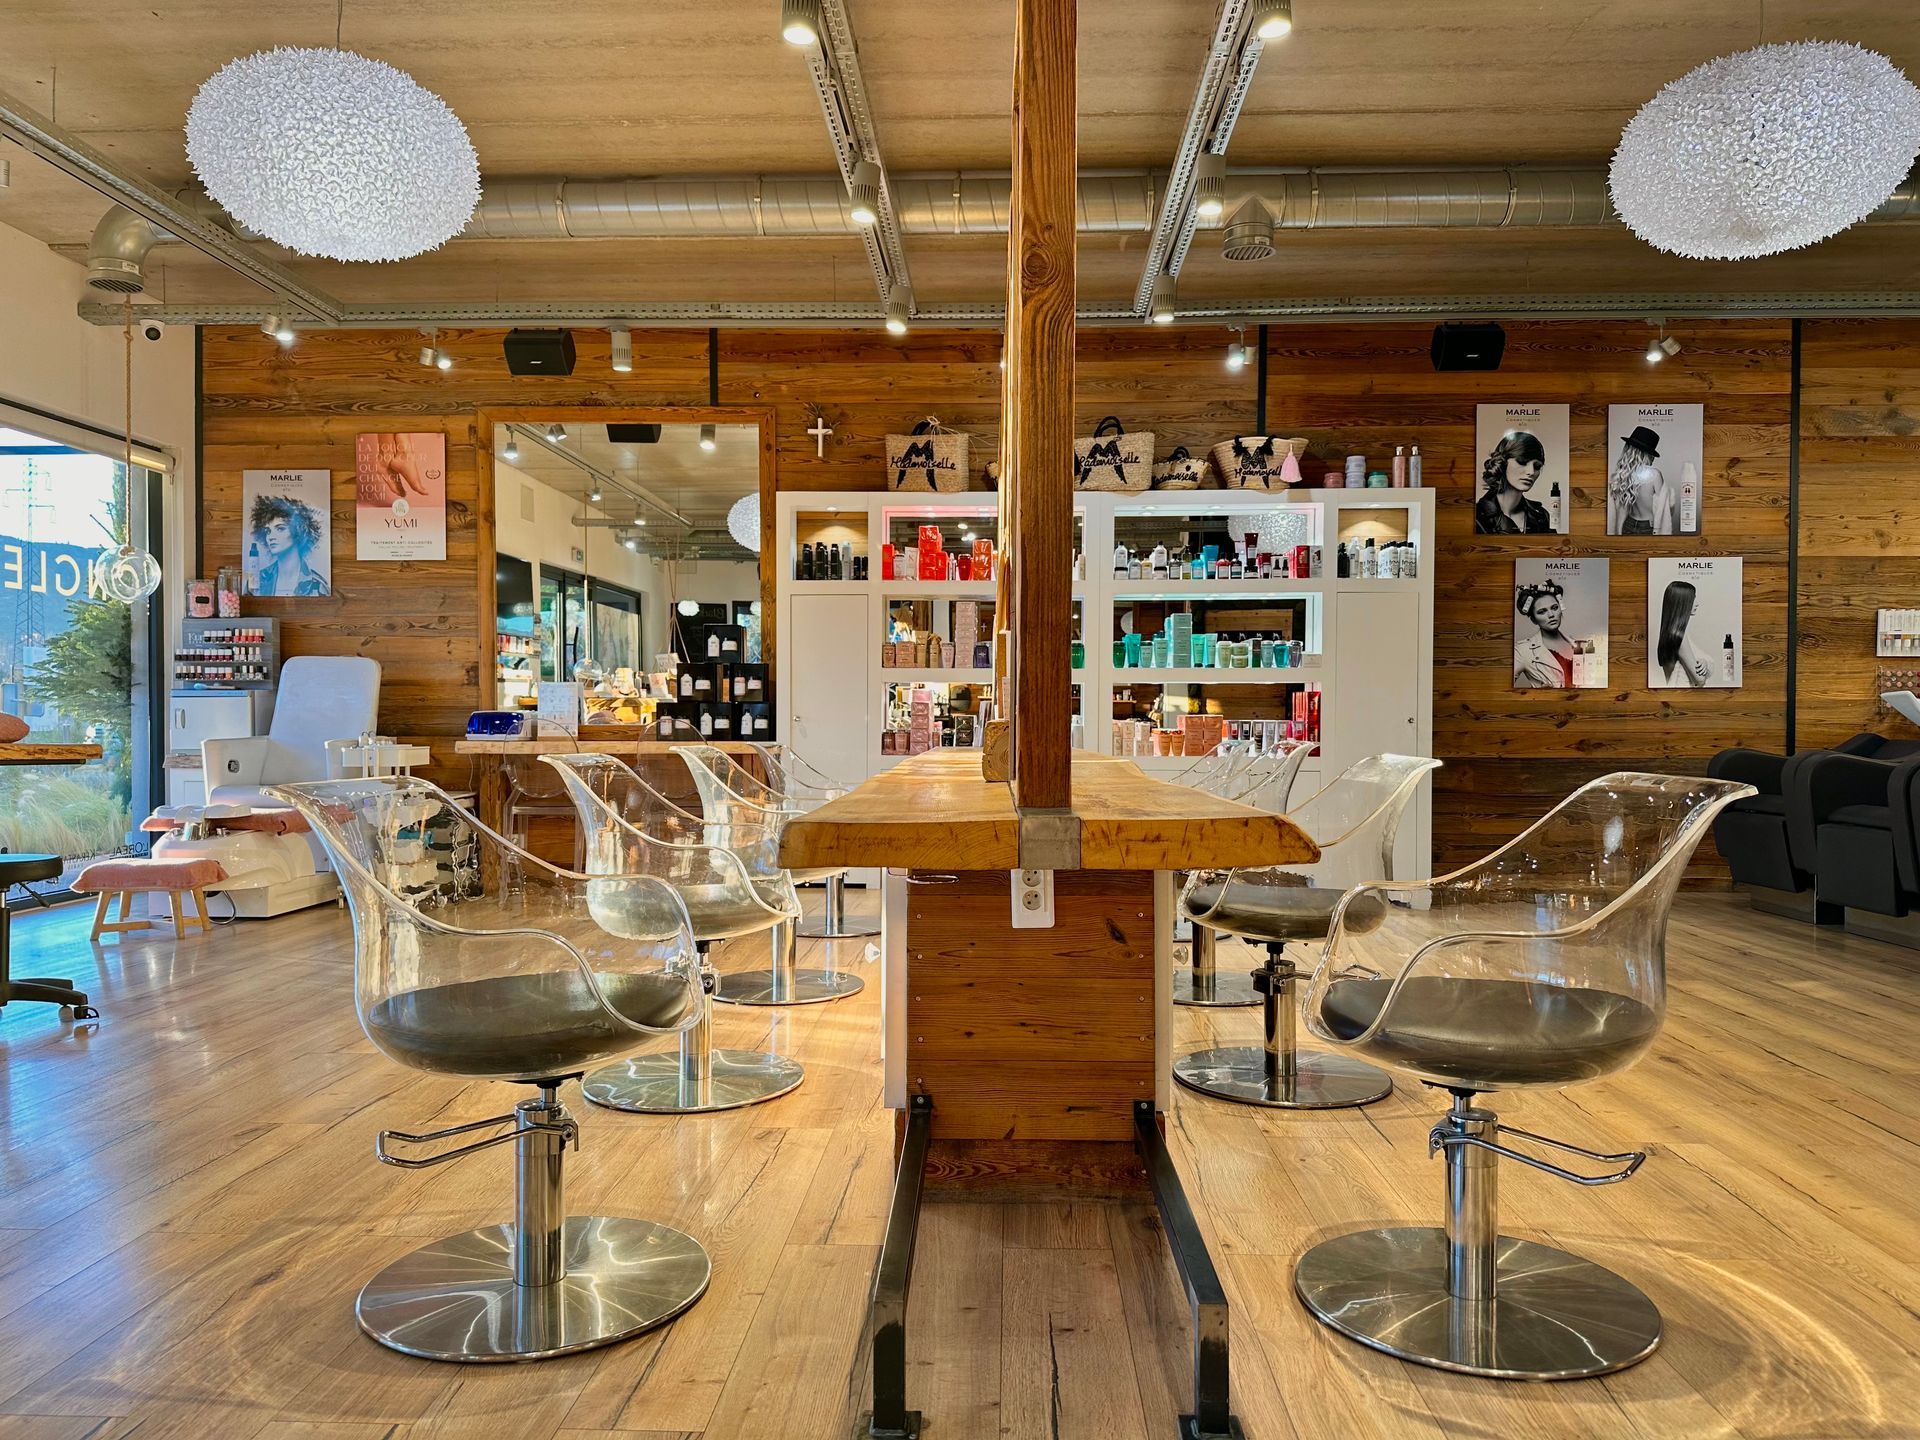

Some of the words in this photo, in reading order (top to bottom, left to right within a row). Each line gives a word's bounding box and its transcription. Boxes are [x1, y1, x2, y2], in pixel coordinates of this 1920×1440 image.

[1505, 408, 1540, 416] MARLIE
[1638, 408, 1674, 416] MARLIE
[358, 443, 372, 452] LA
[358, 454, 376, 462] DE
[359, 464, 378, 473] QUI
[360, 484, 387, 493] TOUT
[359, 493, 387, 501] YUMI
[384, 518, 418, 529] YUMI
